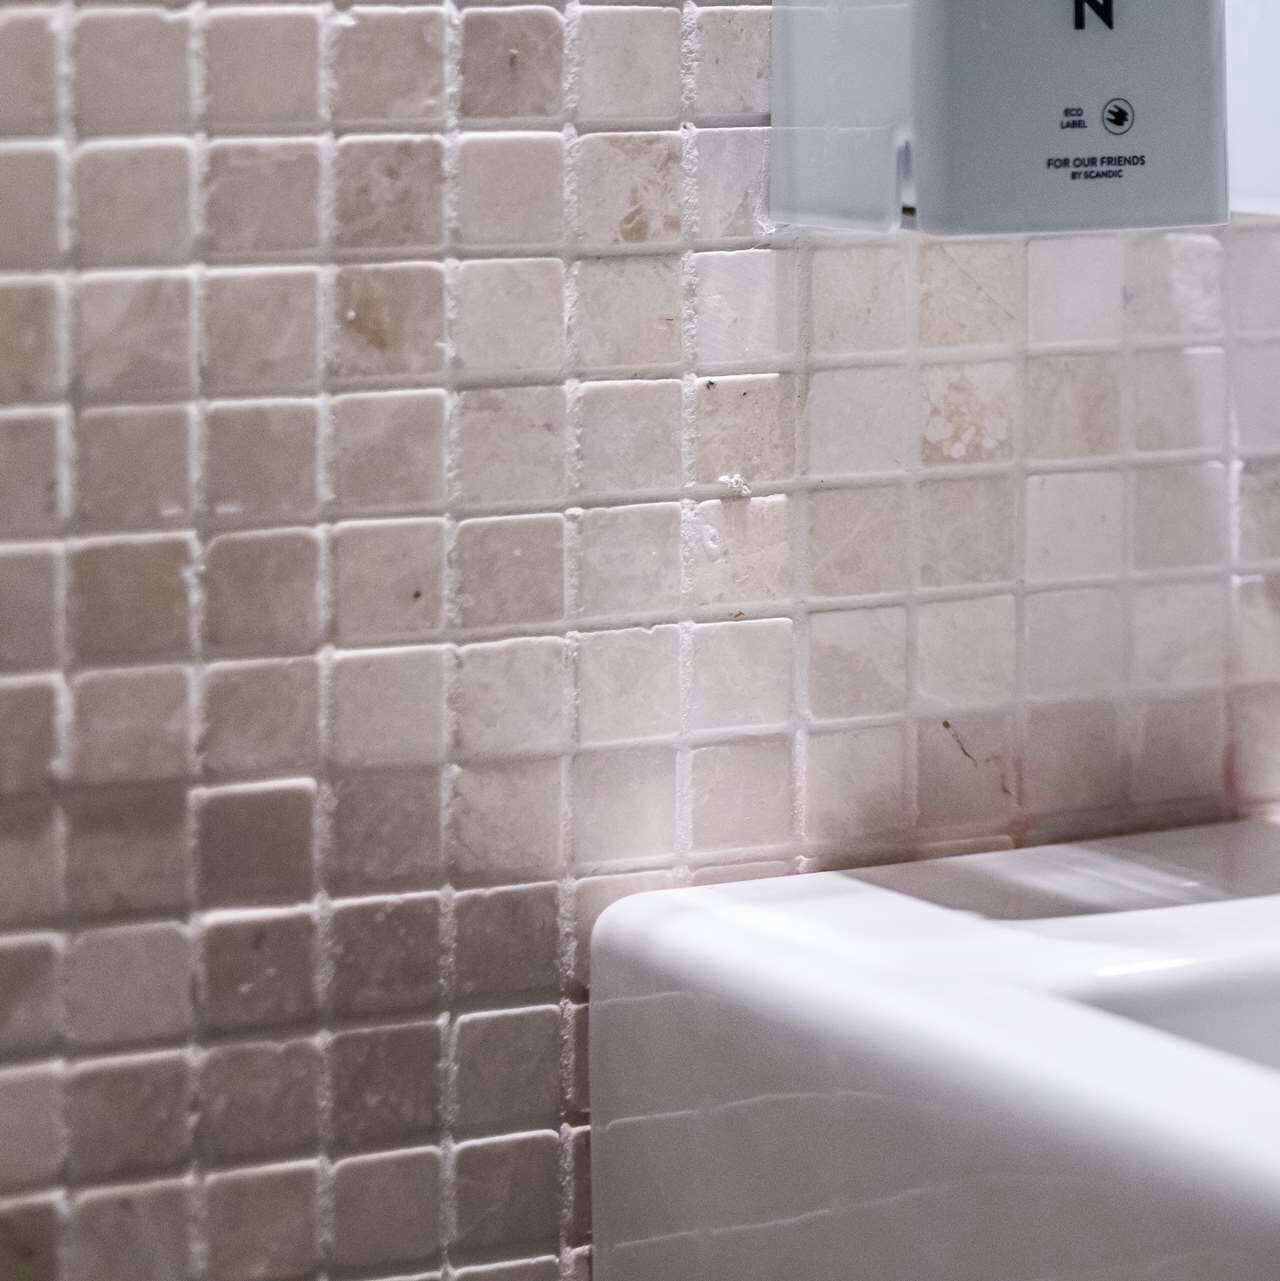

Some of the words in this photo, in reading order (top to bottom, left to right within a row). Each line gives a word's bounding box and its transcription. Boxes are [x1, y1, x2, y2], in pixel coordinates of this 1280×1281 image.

[1063, 107, 1084, 117] ECO
[1060, 120, 1088, 129] LABEL
[1047, 158, 1070, 169] FOR
[1072, 157, 1098, 168] OUR
[1100, 155, 1146, 166] FRIENDS
[1070, 171, 1082, 180] BY
[1083, 169, 1123, 178] SCANDIC
